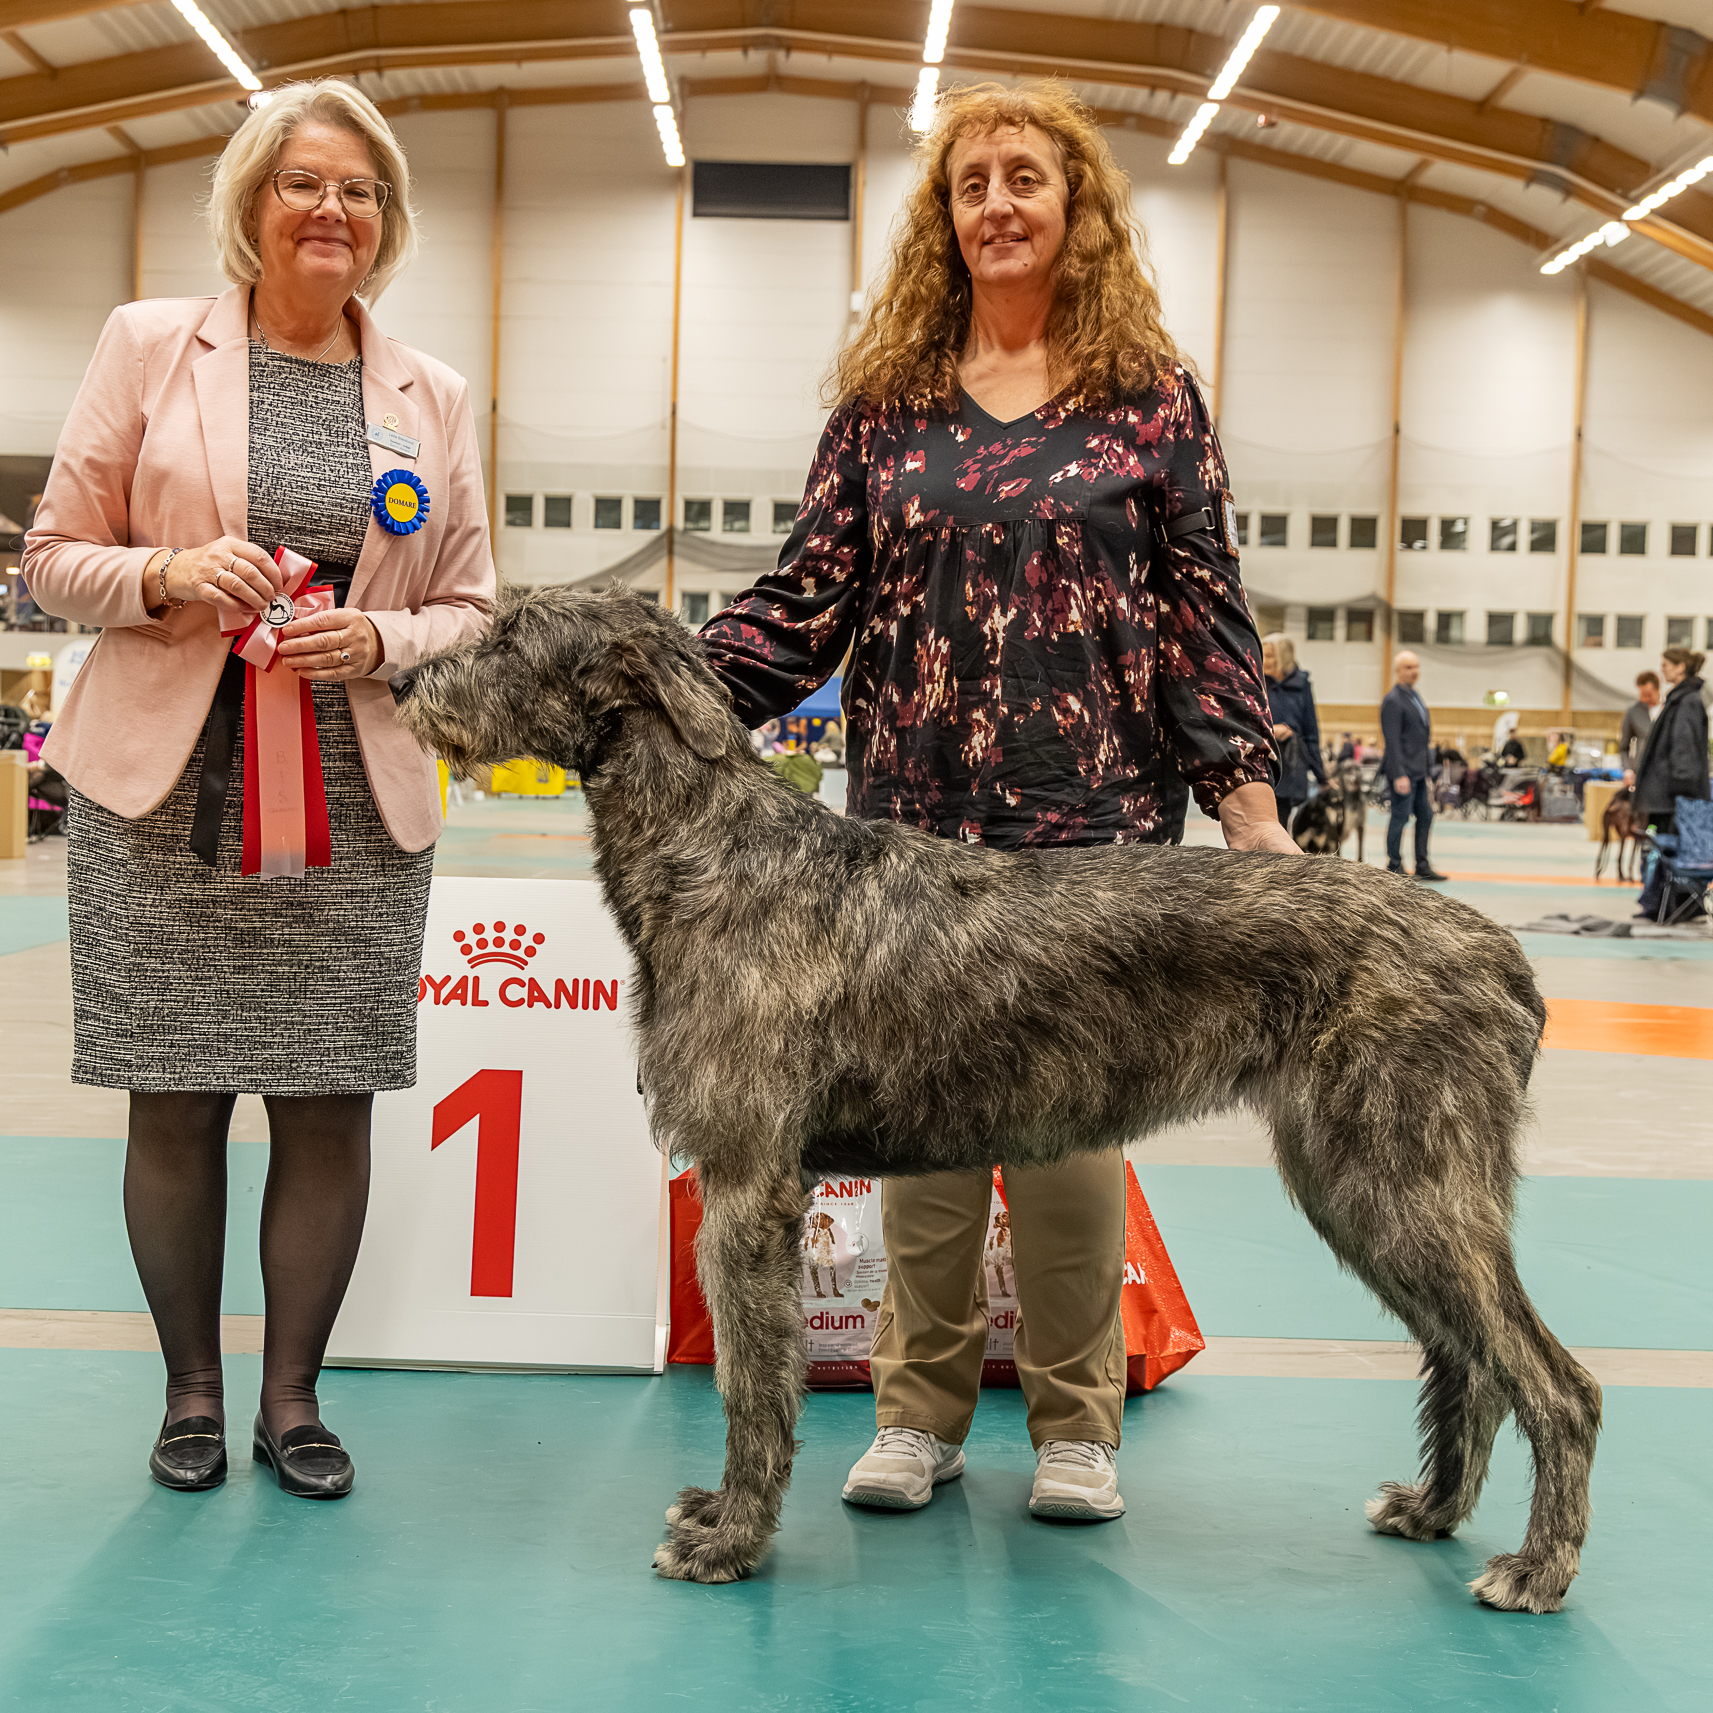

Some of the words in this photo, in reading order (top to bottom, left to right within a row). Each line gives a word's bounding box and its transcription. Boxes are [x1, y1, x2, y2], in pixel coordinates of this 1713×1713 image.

[388, 496, 417, 509] DOMARE
[498, 976, 618, 1011] CANIN
[431, 1068, 523, 1298] 1
